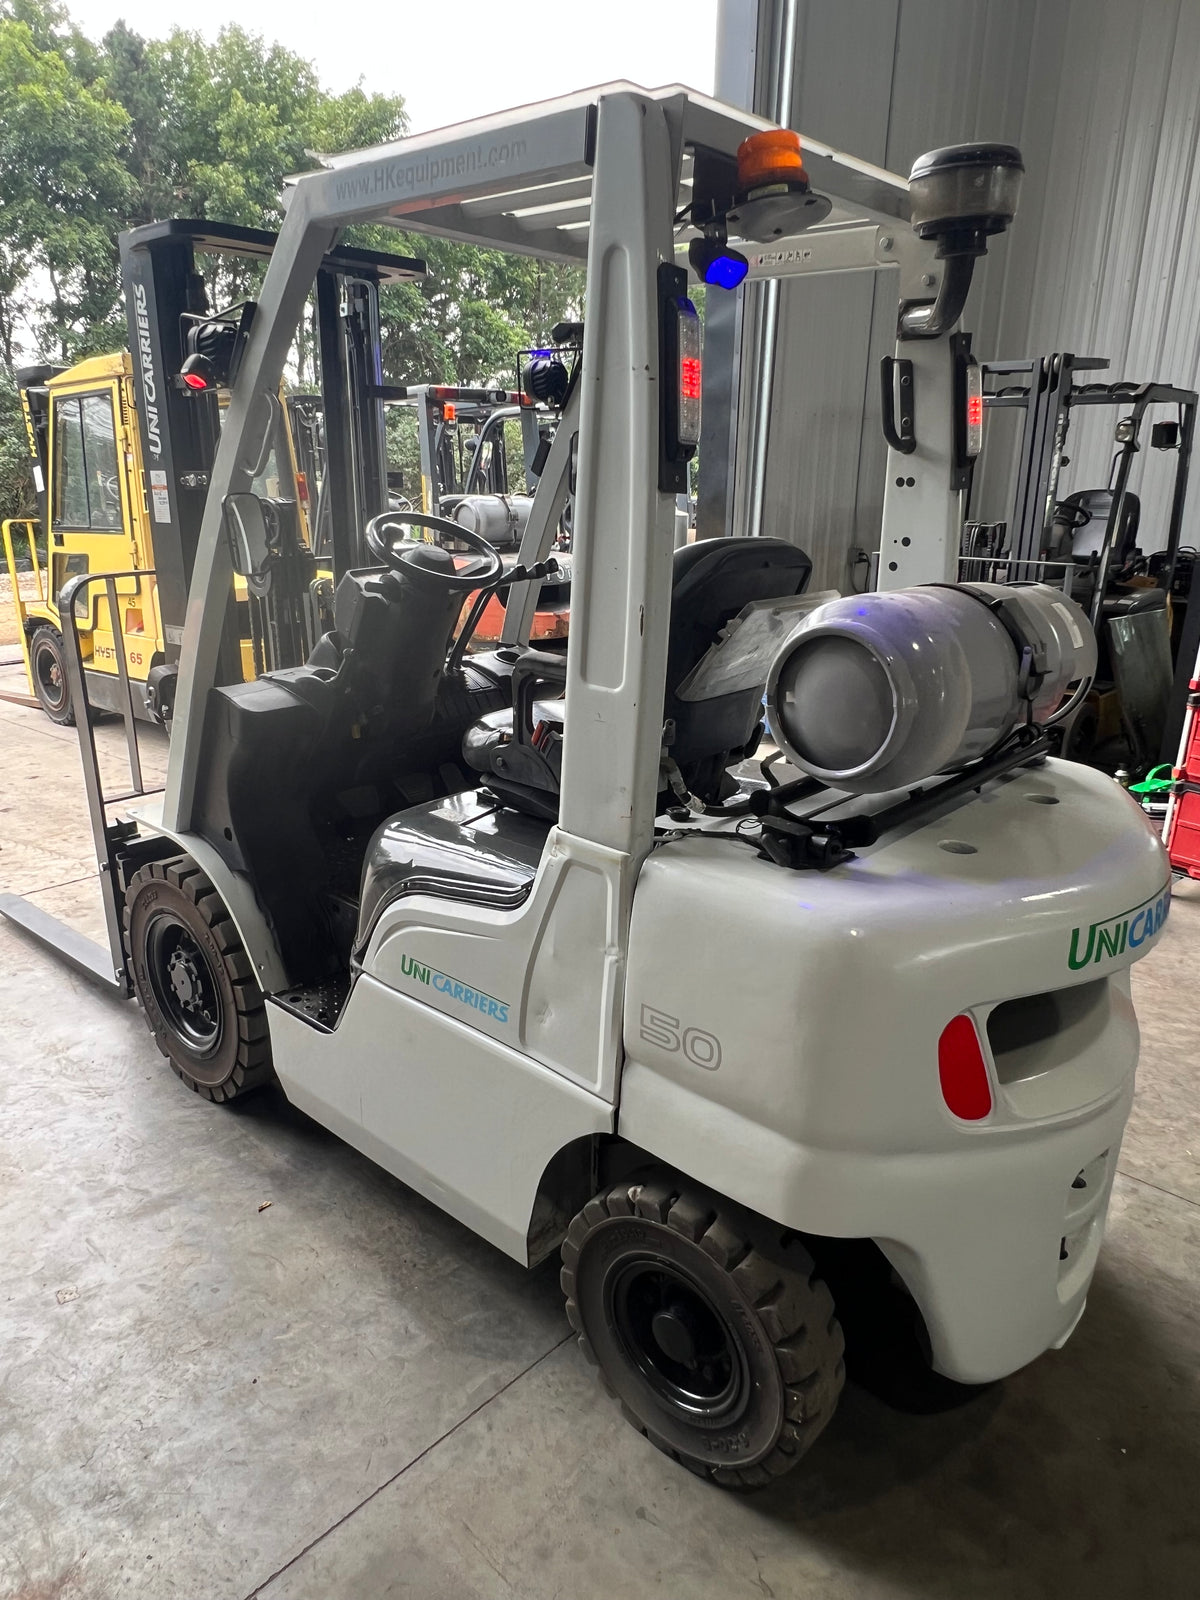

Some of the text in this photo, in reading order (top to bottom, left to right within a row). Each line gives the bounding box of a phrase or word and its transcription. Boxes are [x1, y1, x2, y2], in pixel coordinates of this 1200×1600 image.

[336, 140, 527, 200] www.HKequipment.com
[95, 646, 116, 659] HYST
[130, 652, 143, 665] 65
[640, 1003, 722, 1071] 50
